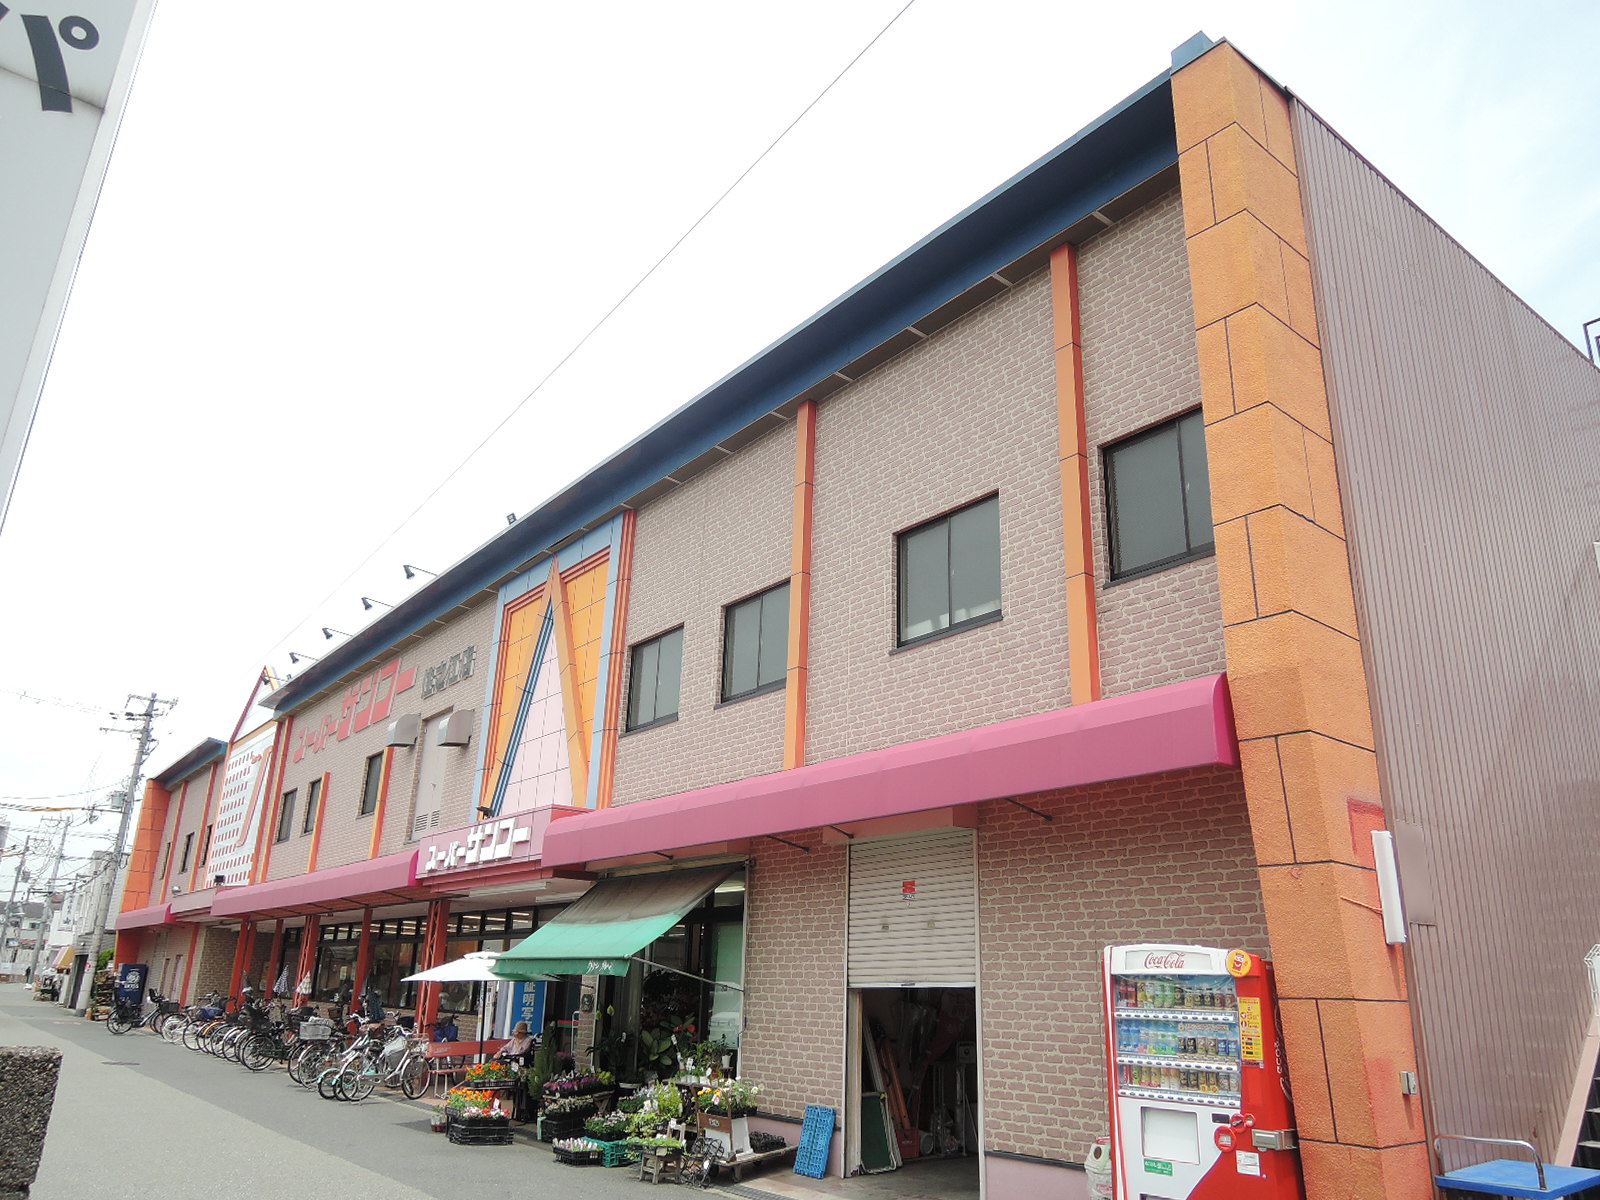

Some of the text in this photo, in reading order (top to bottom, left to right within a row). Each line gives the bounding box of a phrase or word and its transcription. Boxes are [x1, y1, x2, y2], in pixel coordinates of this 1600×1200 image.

[425, 818, 529, 871] スーパーサンコー
[1144, 951, 1186, 969] Coca-Cola
